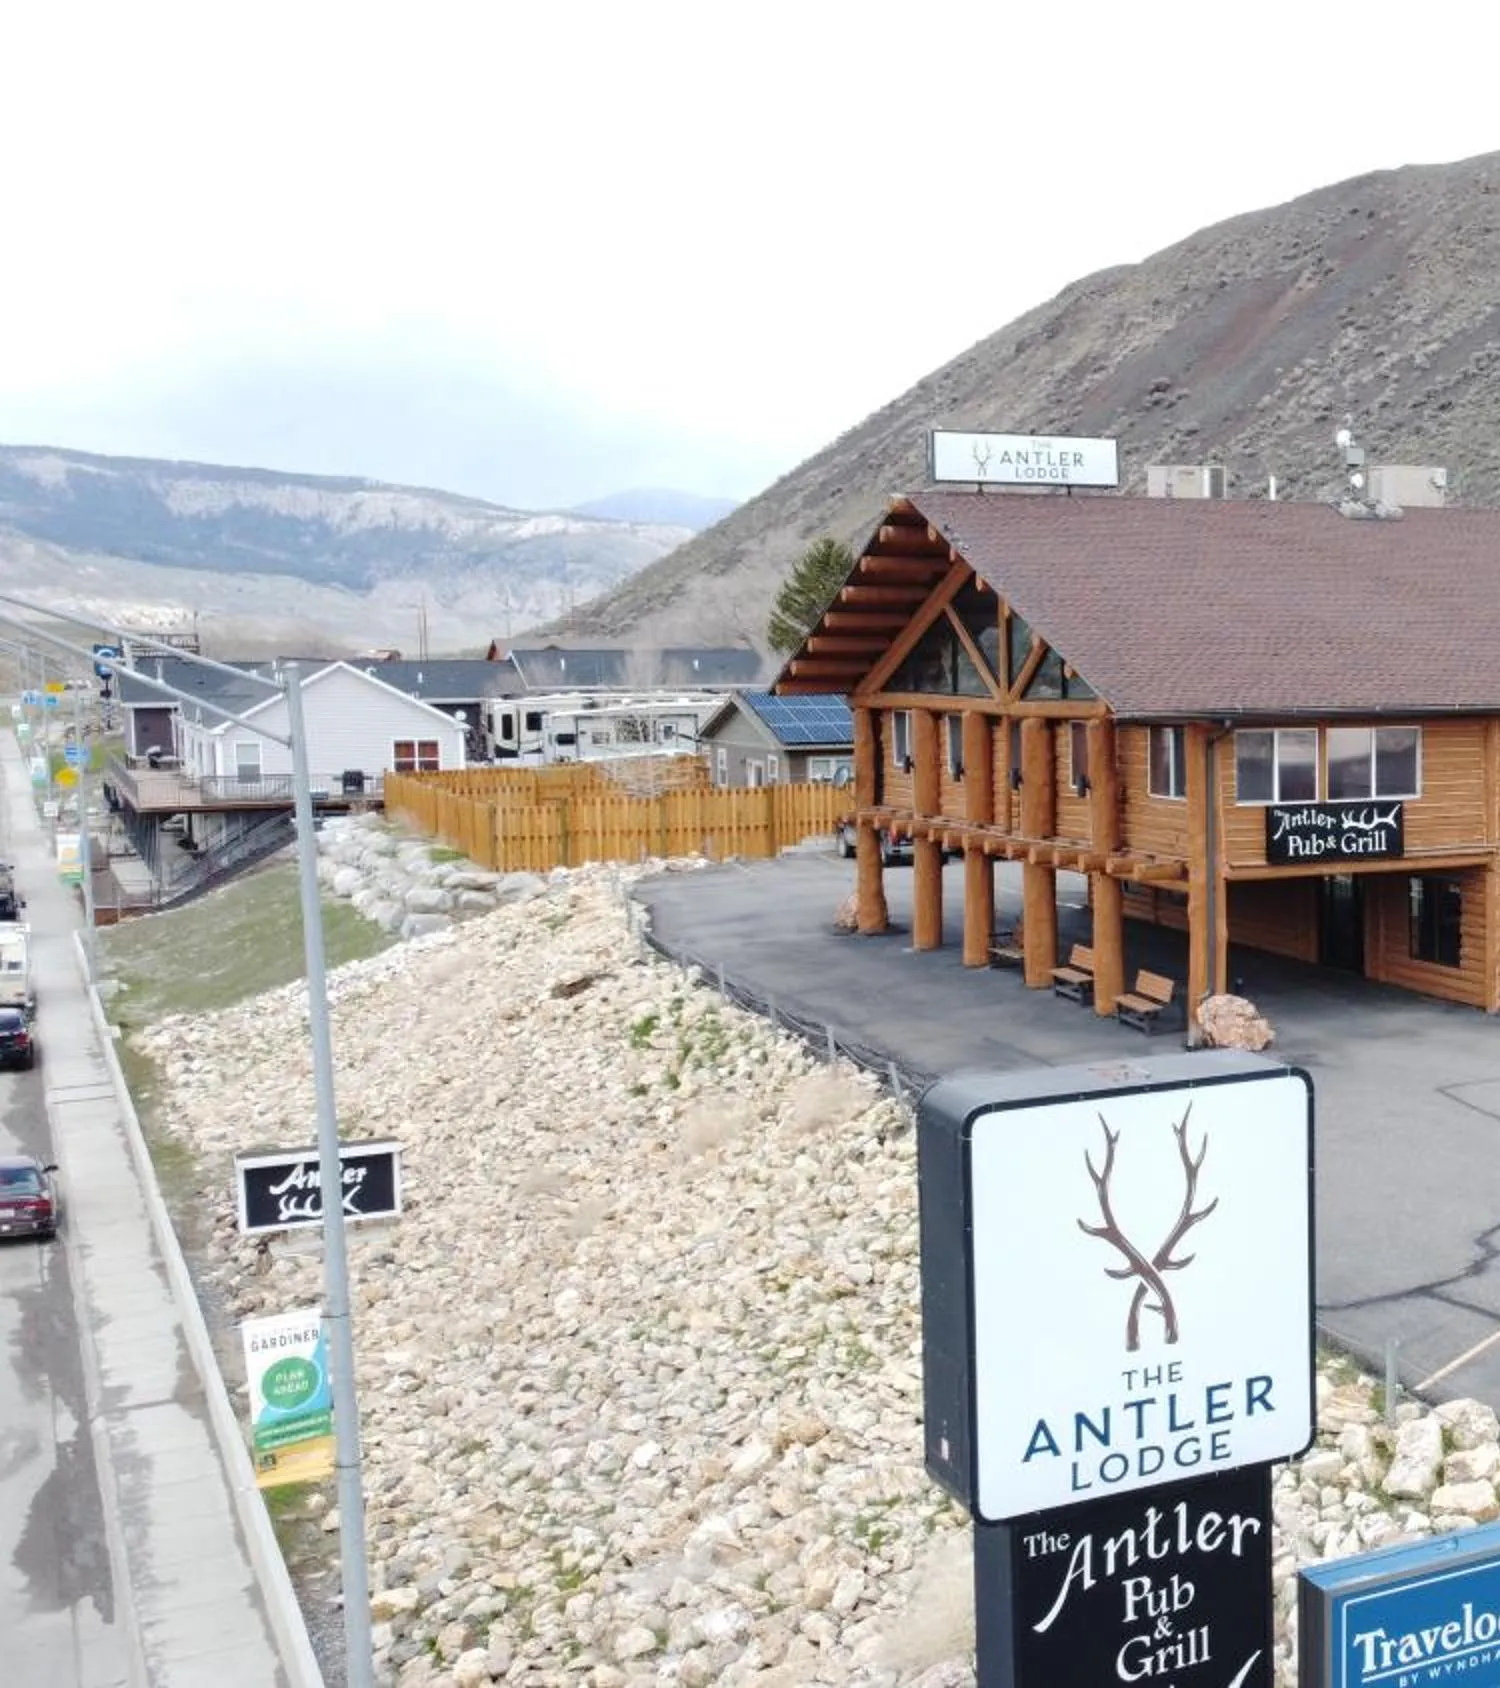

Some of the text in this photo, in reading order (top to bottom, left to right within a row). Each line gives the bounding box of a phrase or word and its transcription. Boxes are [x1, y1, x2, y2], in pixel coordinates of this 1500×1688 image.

[1000, 450, 1084, 467] ANTLER
[1015, 466, 1070, 479] LODGE
[1272, 808, 1337, 840] Antler
[1288, 830, 1388, 856] Pub & Grill
[251, 1328, 319, 1352] GARDINER
[1122, 1361, 1183, 1390] THE
[1022, 1375, 1275, 1463] ANTLER
[1071, 1430, 1232, 1491] LODGE
[1024, 1501, 1261, 1633] The Antler
[1122, 1574, 1195, 1623] Pub
[1153, 1615, 1173, 1639] &
[1116, 1625, 1212, 1682] Grill
[1399, 1673, 1419, 1688] BY
